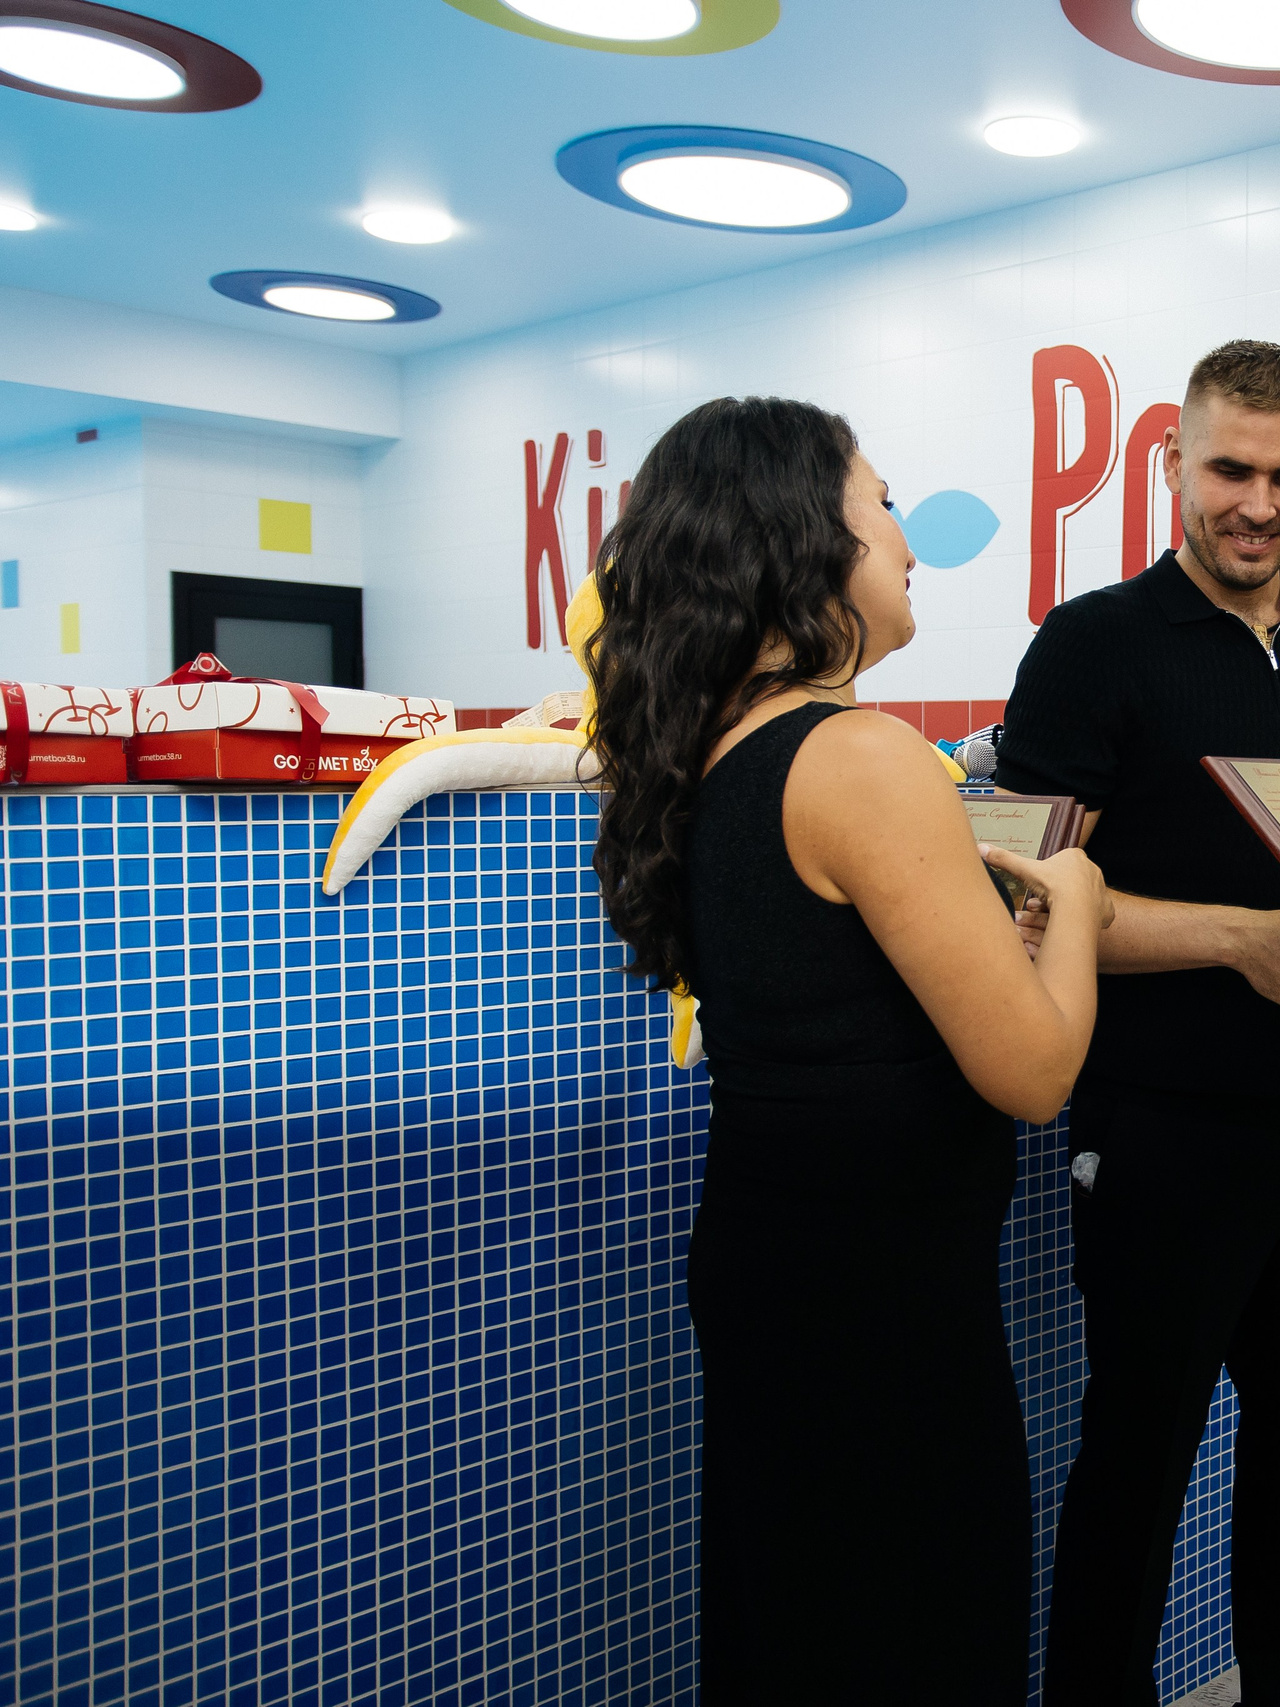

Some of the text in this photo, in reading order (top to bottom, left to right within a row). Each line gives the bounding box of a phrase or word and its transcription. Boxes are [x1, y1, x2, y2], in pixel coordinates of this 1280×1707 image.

[29, 753, 86, 764] urmetbox38.ru
[138, 751, 183, 763] urmetbox38.ru
[273, 754, 349, 771] GOMET
